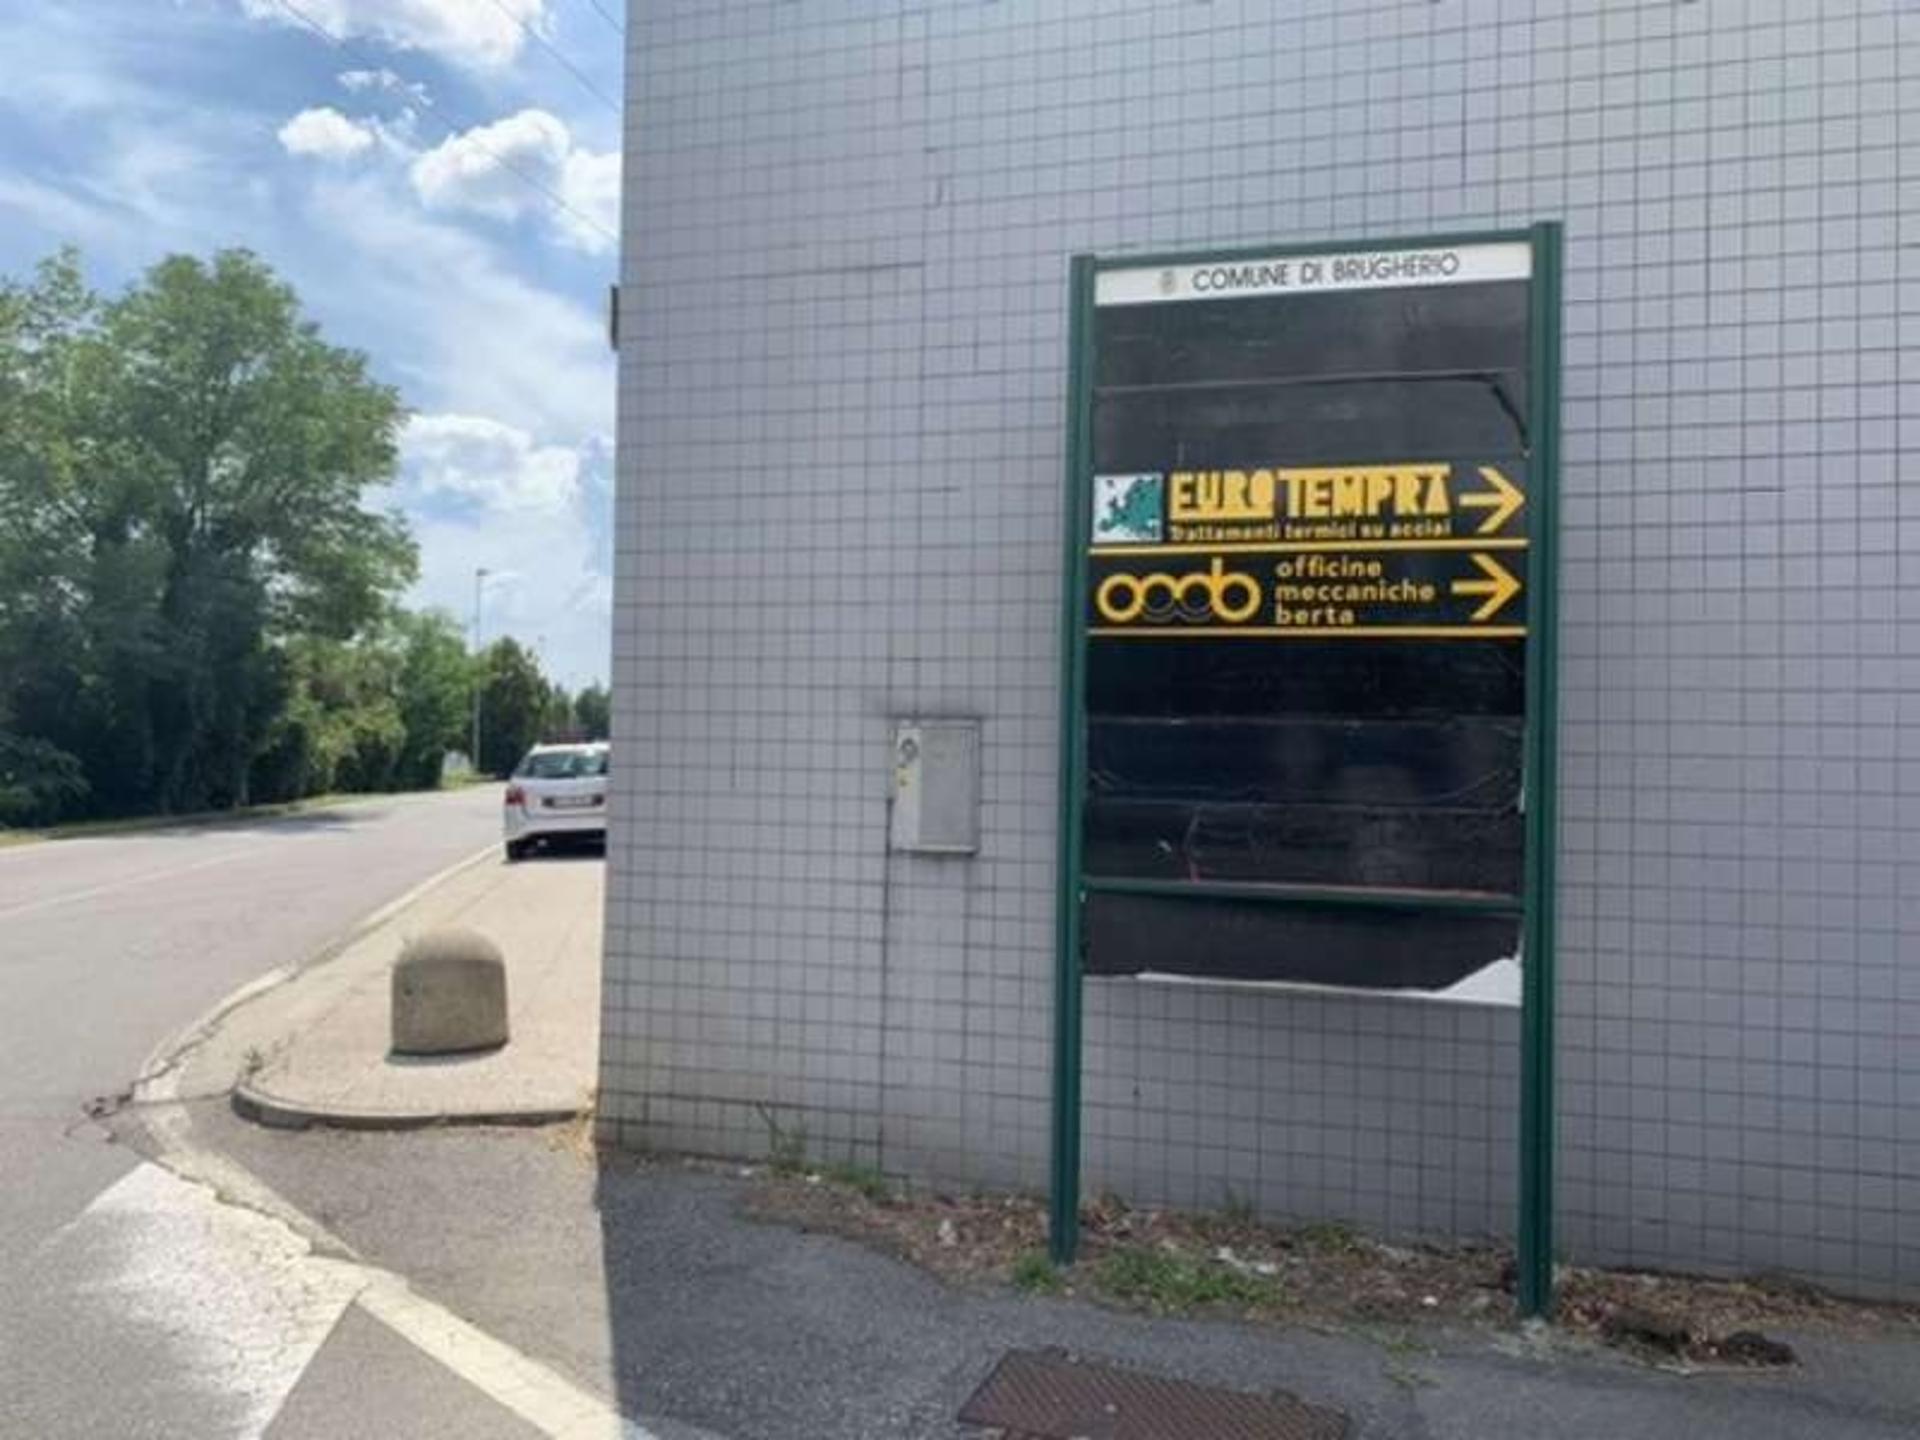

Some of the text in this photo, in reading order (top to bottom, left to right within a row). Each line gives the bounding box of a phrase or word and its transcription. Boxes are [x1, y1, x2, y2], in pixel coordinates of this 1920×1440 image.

[1192, 252, 1460, 291] COMUNE DI BRUGHERIO
[1275, 555, 1382, 577] officine
[1275, 578, 1436, 601] meccaniche
[1275, 603, 1355, 625] berta
